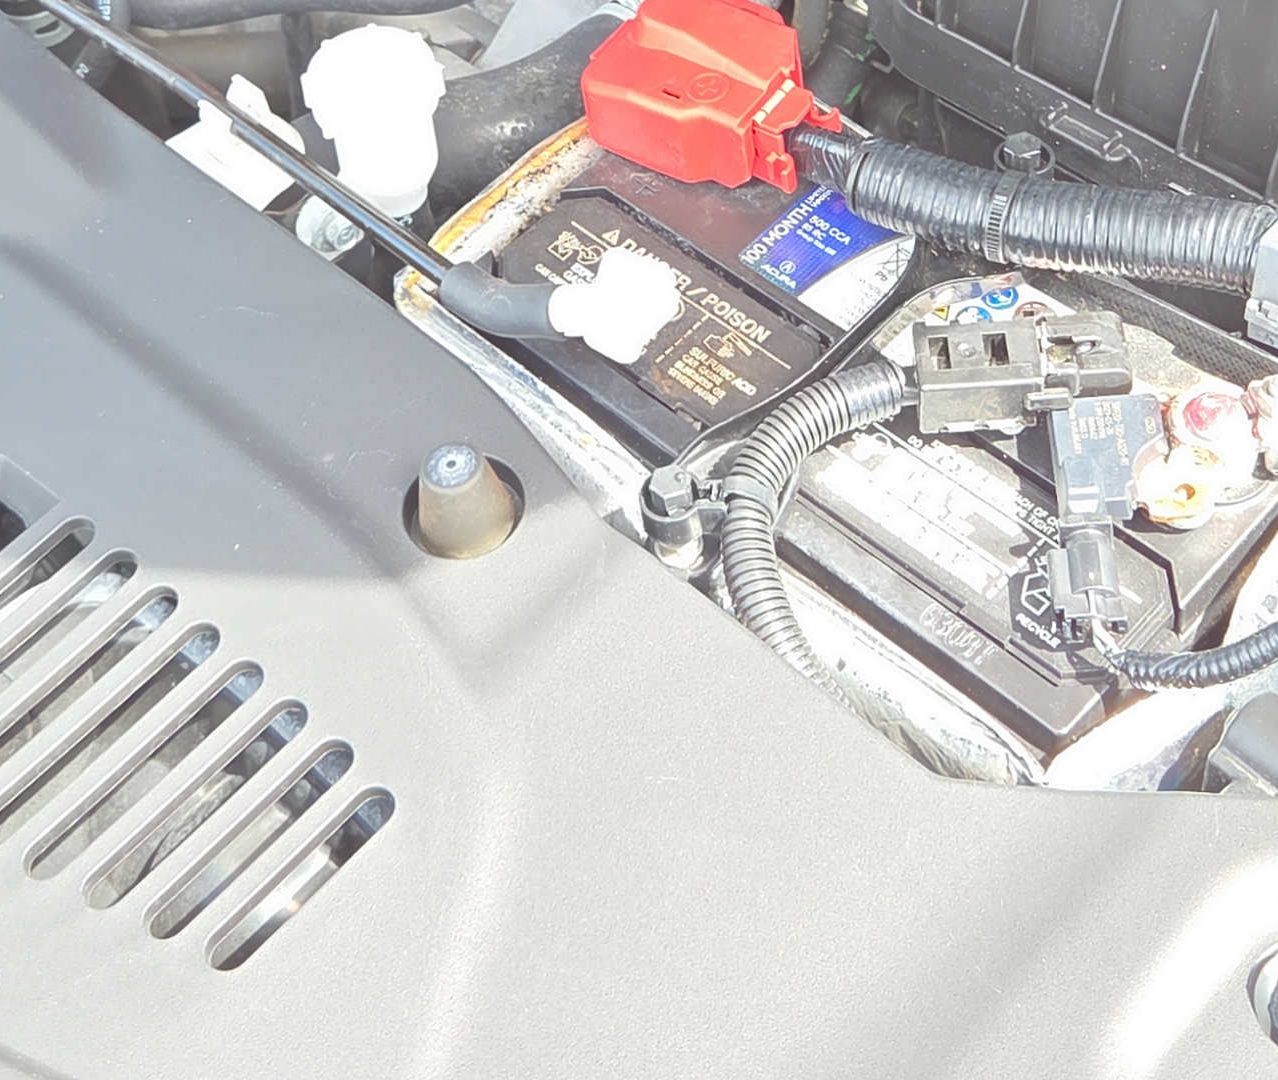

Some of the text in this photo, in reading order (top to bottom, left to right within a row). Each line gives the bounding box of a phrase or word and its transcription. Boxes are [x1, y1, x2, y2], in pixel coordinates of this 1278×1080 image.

[741, 244, 768, 265] 100
[763, 203, 813, 248] MONTH
[808, 215, 852, 246] 500 CCA
[760, 263, 798, 290] ACURA
[874, 269, 889, 282] Pb
[699, 292, 772, 344] POISON
[688, 347, 758, 397] SULFURIC ACID
[696, 364, 724, 386] CAUSE
[1026, 513, 1055, 536] TIGHT
[1033, 505, 1048, 519] OF
[1015, 612, 1062, 649] RECYCLE
